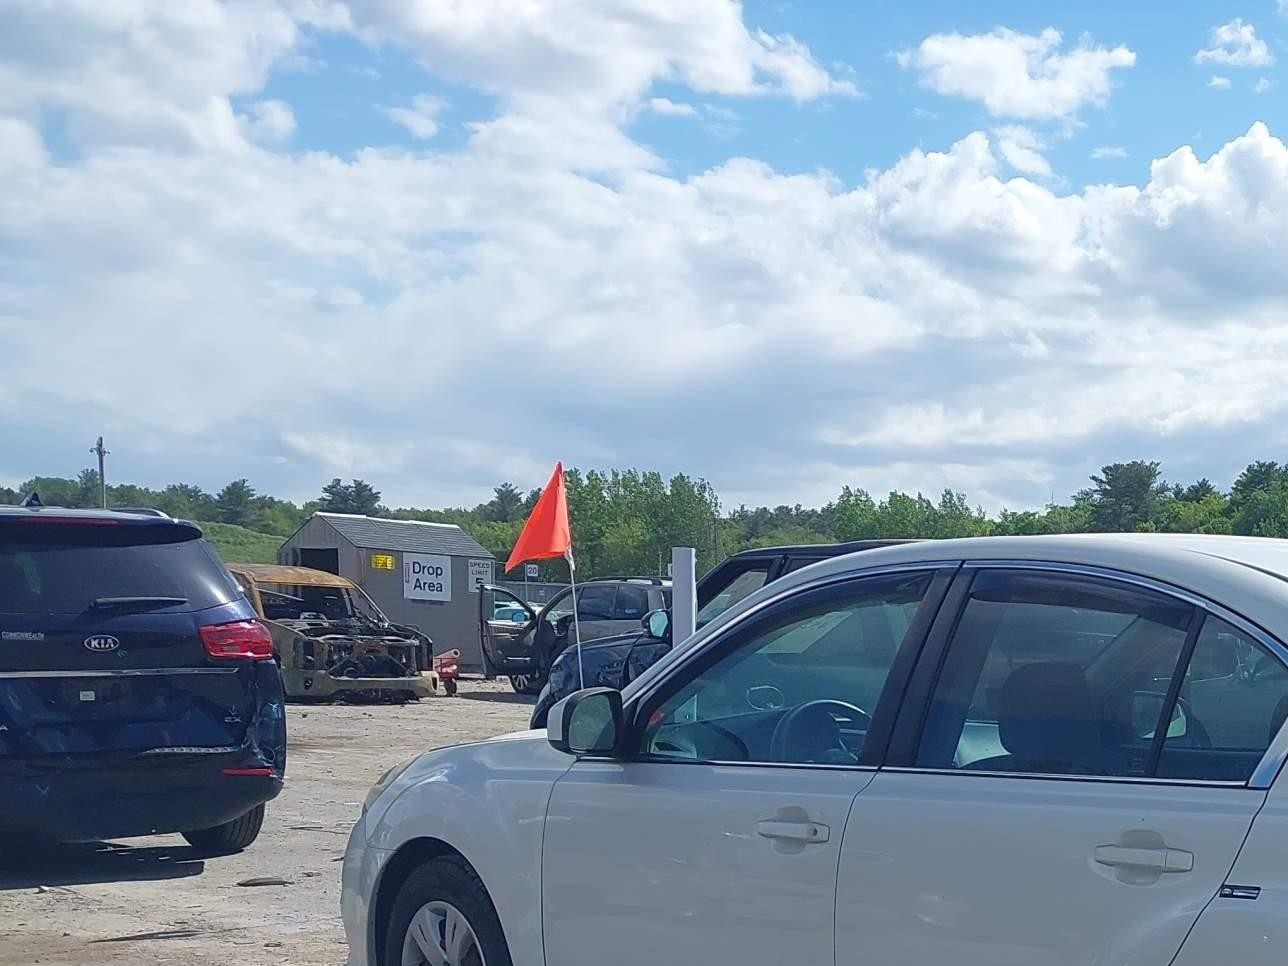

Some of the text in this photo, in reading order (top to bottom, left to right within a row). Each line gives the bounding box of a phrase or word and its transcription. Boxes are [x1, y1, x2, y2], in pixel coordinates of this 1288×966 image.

[412, 561, 443, 578] Drop
[527, 567, 537, 575] 20
[413, 577, 443, 592] Area
